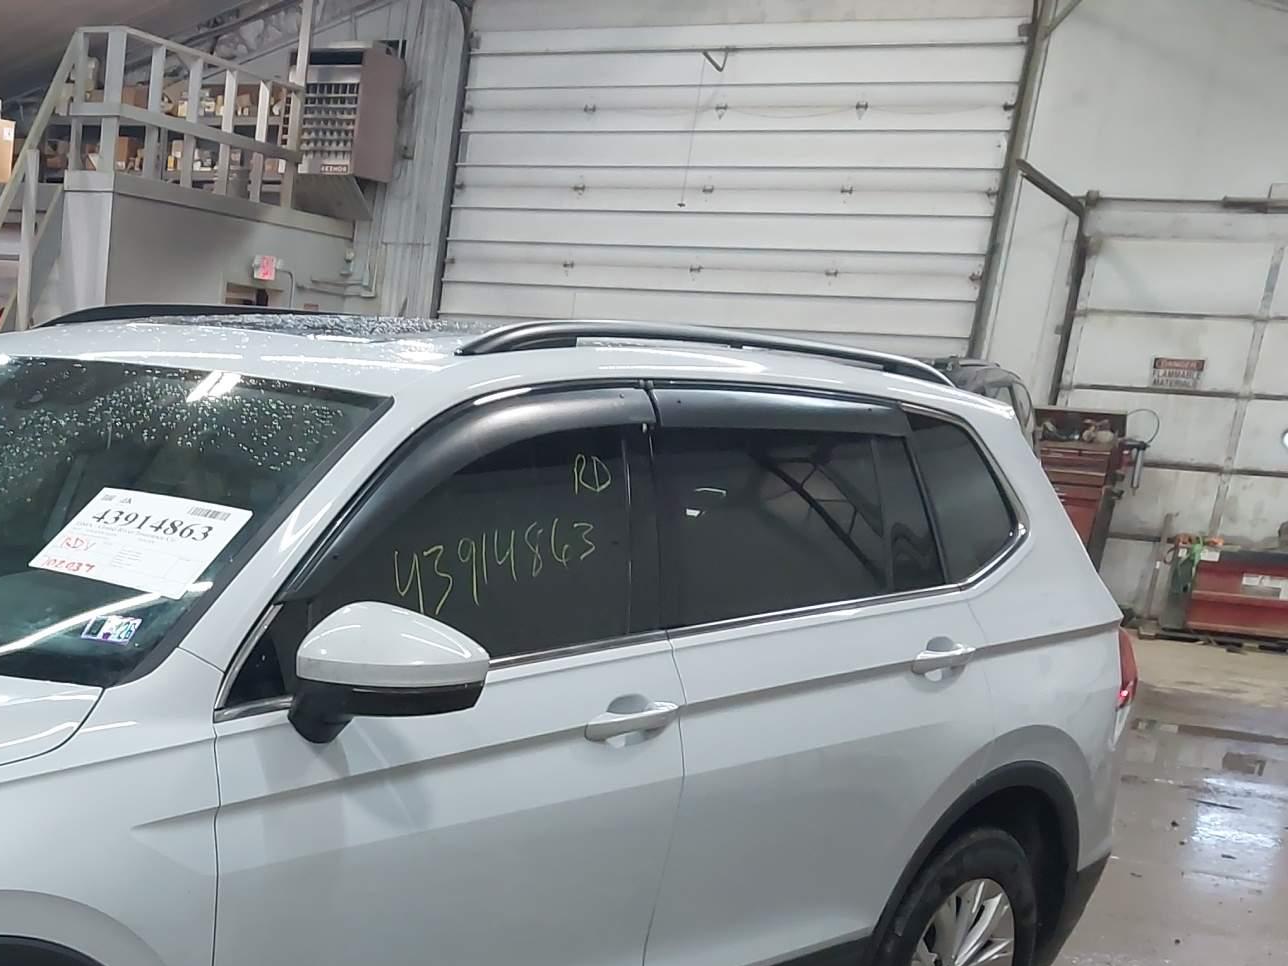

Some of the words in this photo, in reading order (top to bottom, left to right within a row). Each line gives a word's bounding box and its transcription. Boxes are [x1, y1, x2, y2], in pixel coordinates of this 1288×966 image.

[573, 453, 612, 494] RD
[92, 508, 213, 541] 43914863
[394, 517, 596, 615] 43914863
